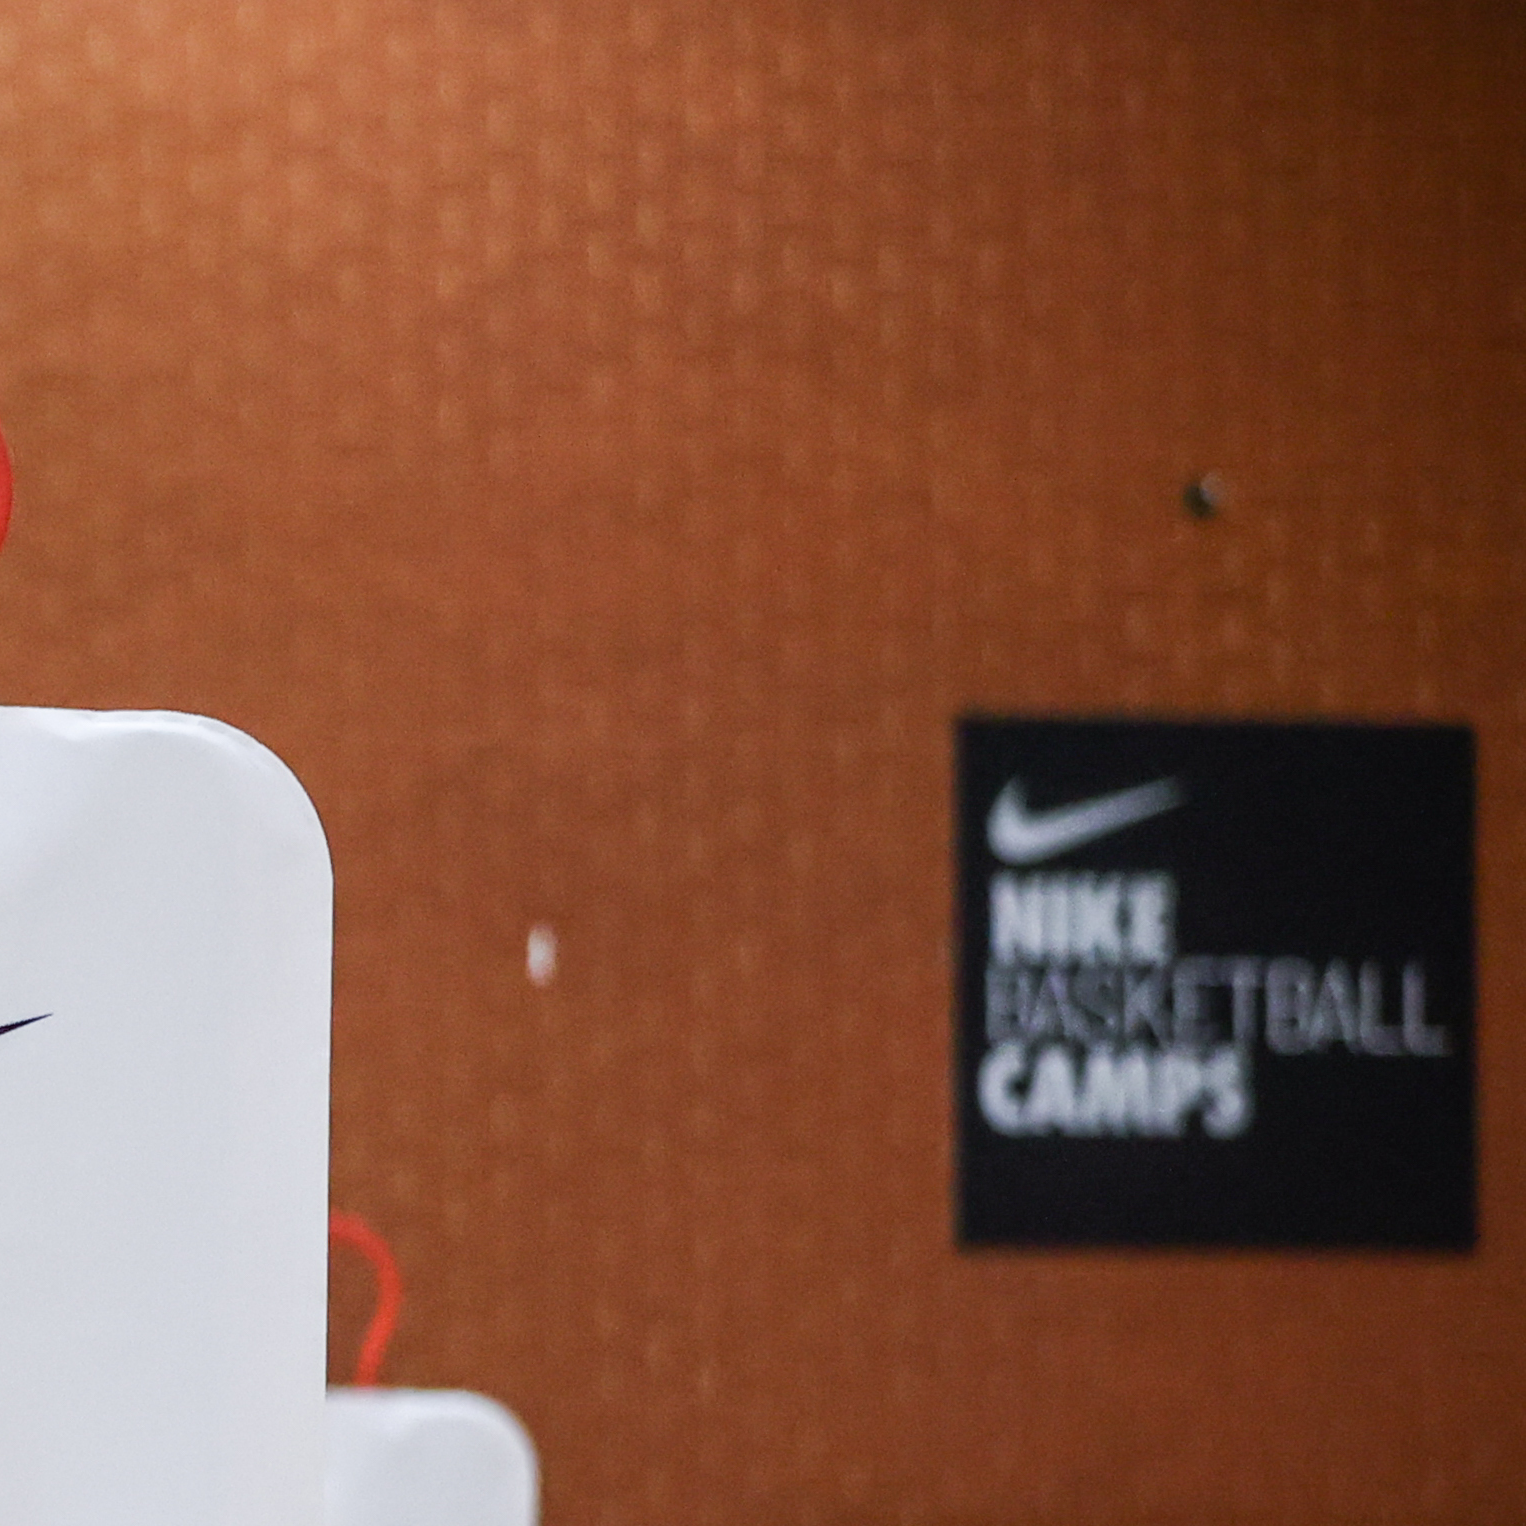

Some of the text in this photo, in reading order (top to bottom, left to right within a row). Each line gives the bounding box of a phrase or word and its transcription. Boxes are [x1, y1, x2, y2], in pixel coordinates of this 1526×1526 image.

[988, 873, 1175, 965] NIKE
[984, 957, 1449, 1056] BASKETBALL
[978, 1043, 1252, 1137] CAMPS
